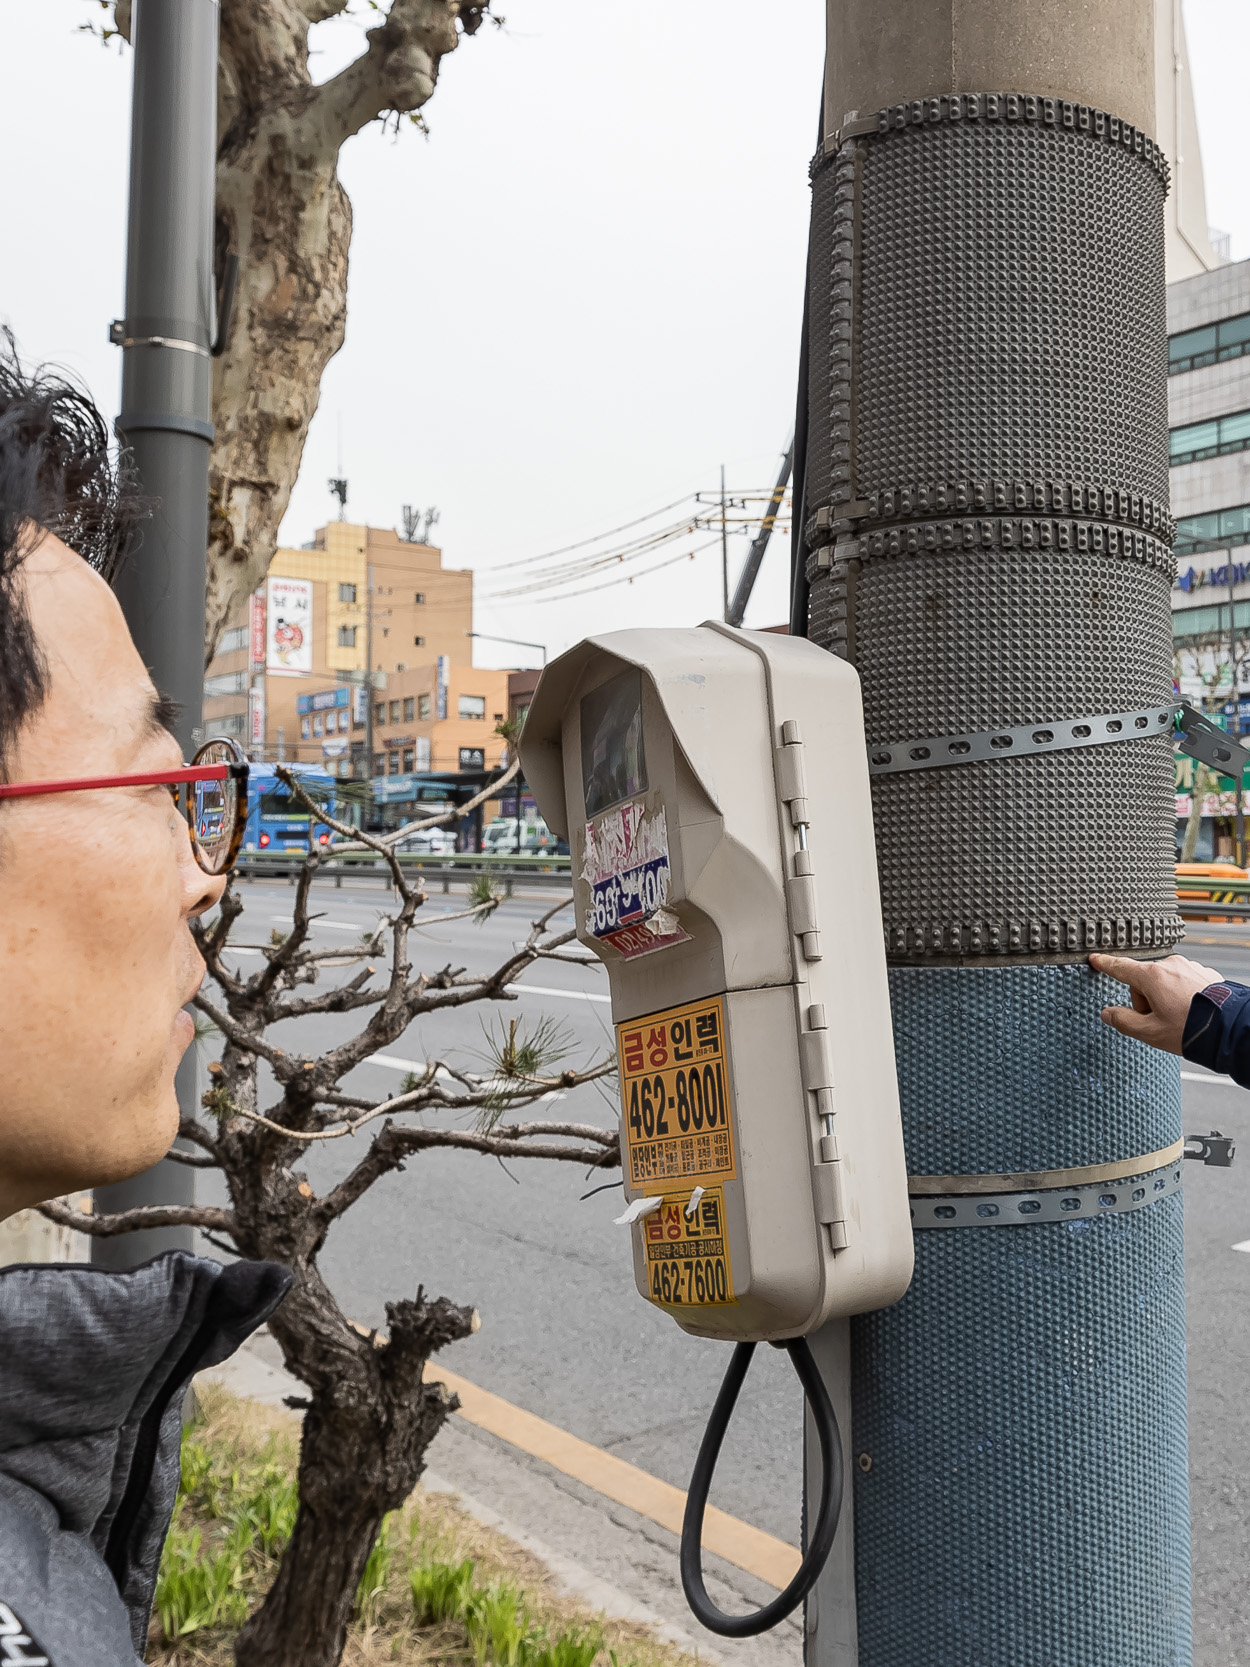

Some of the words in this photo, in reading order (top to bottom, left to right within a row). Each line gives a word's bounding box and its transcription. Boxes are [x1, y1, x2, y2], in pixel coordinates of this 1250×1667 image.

[624, 1011, 720, 1072] 금성인력
[630, 1062, 726, 1139] 462-8001
[652, 1258, 727, 1303] 462-7600
